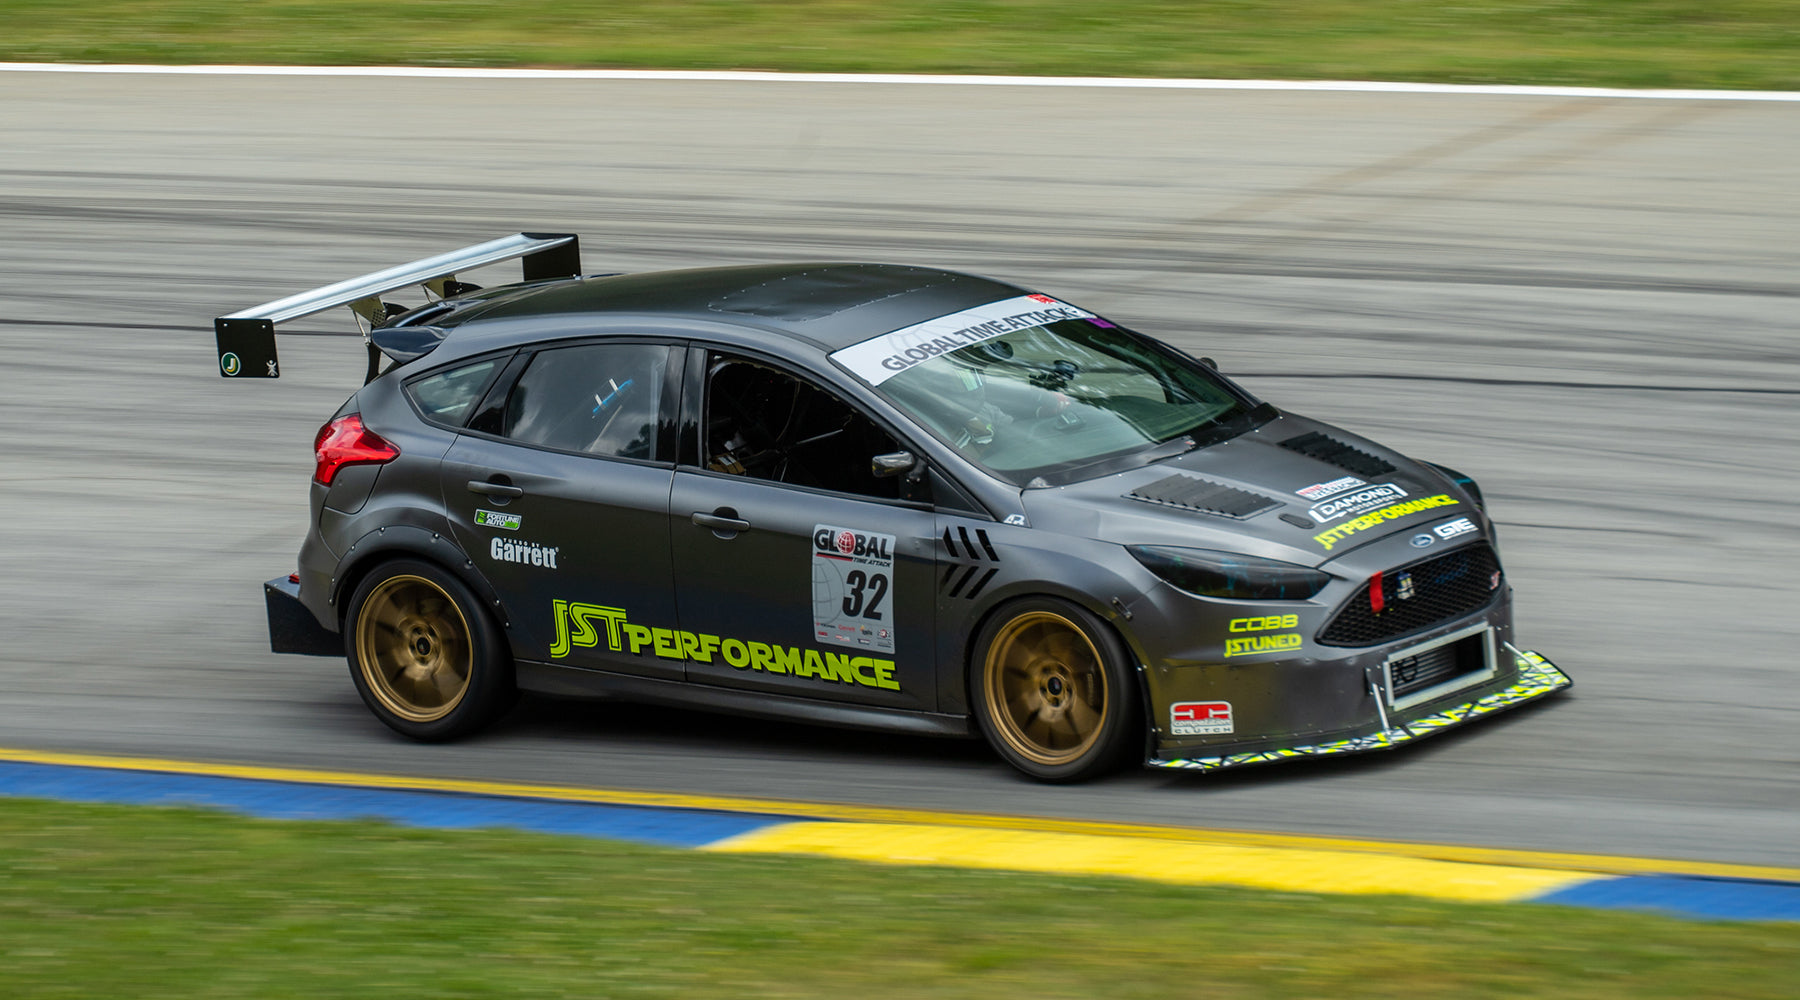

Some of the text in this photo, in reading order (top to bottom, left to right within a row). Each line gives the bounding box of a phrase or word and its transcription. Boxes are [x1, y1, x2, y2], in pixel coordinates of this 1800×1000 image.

[881, 306, 1072, 371] GLOBAL TIME ATTACK
[1320, 486, 1395, 516] DAMOND
[486, 519, 506, 528] AUTO
[490, 537, 559, 570] Garrett
[814, 529, 892, 560] GLOBAL
[853, 556, 891, 569] TIME ATTACK
[842, 570, 888, 621] 32
[1229, 614, 1299, 633] COBB
[1224, 633, 1302, 658] JSTUNED
